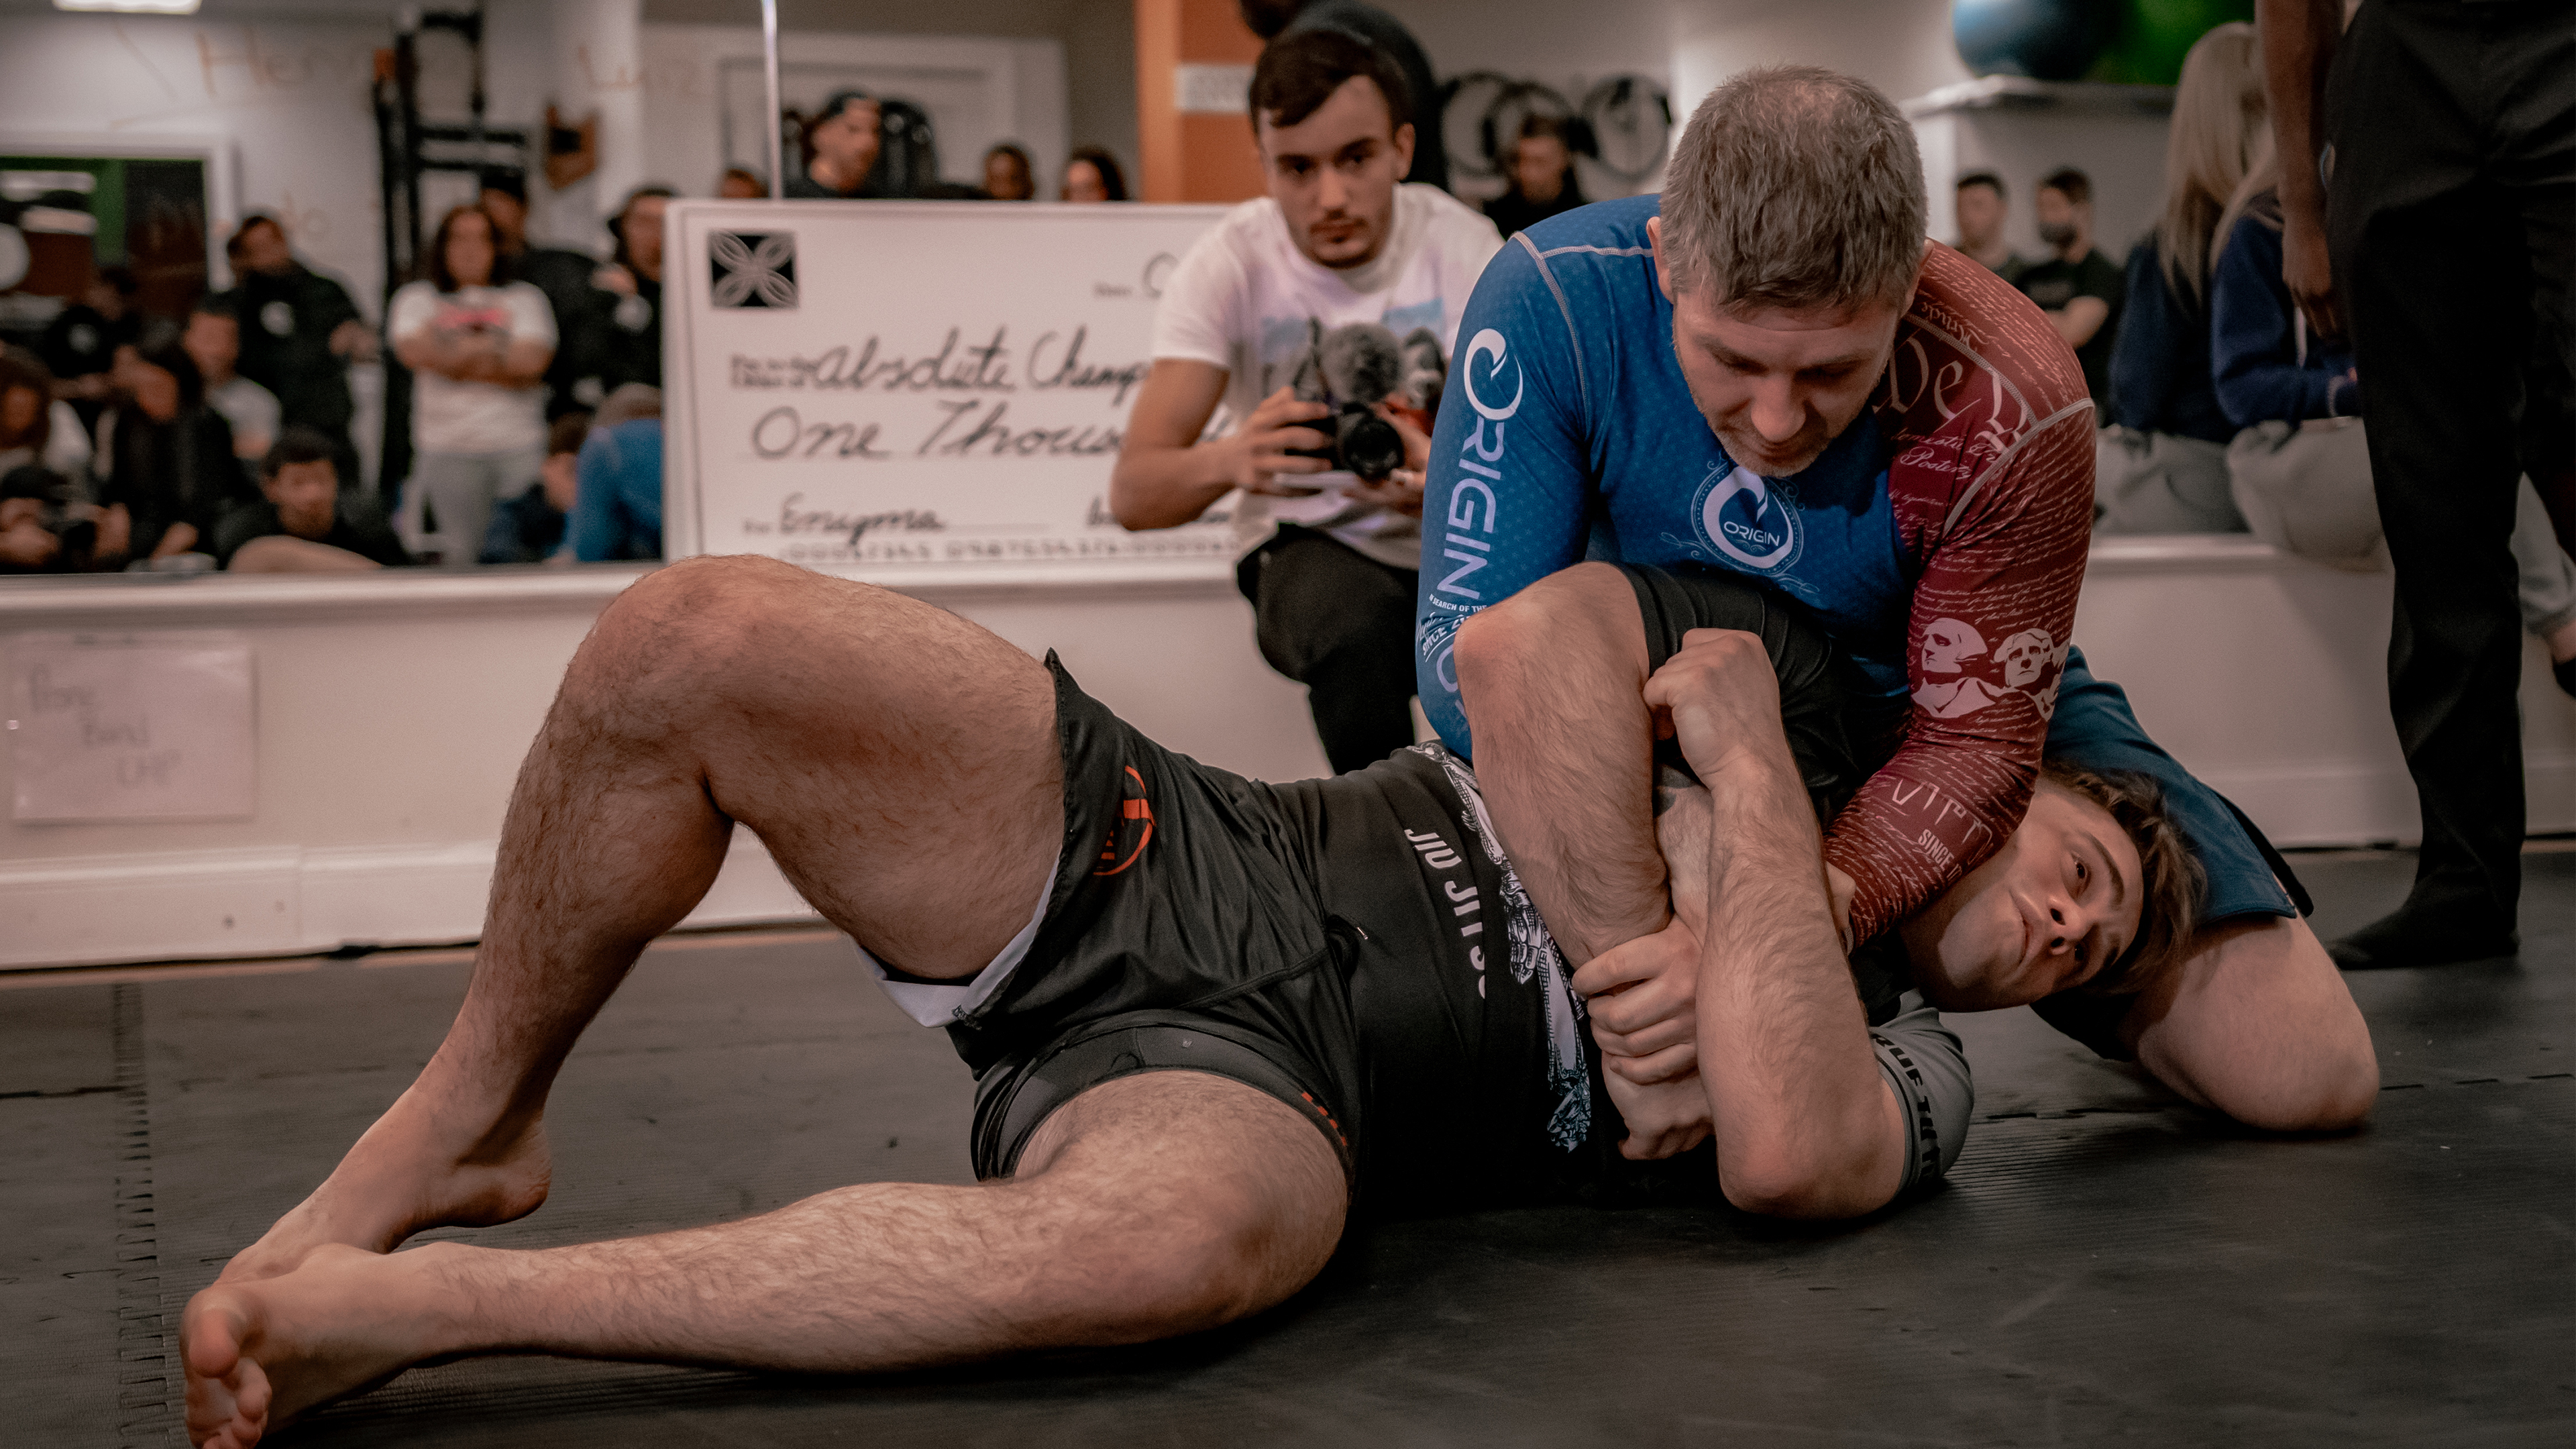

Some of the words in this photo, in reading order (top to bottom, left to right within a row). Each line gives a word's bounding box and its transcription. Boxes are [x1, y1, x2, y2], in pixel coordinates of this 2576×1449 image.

[751, 405, 890, 460] One
[917, 399, 1129, 458] Thous
[1723, 521, 1780, 547] ORIGIN
[1432, 597, 1457, 611] SEARCH
[1459, 604, 1470, 612] OF
[1404, 828, 1462, 869] JIU
[1917, 828, 1955, 870] SINCE
